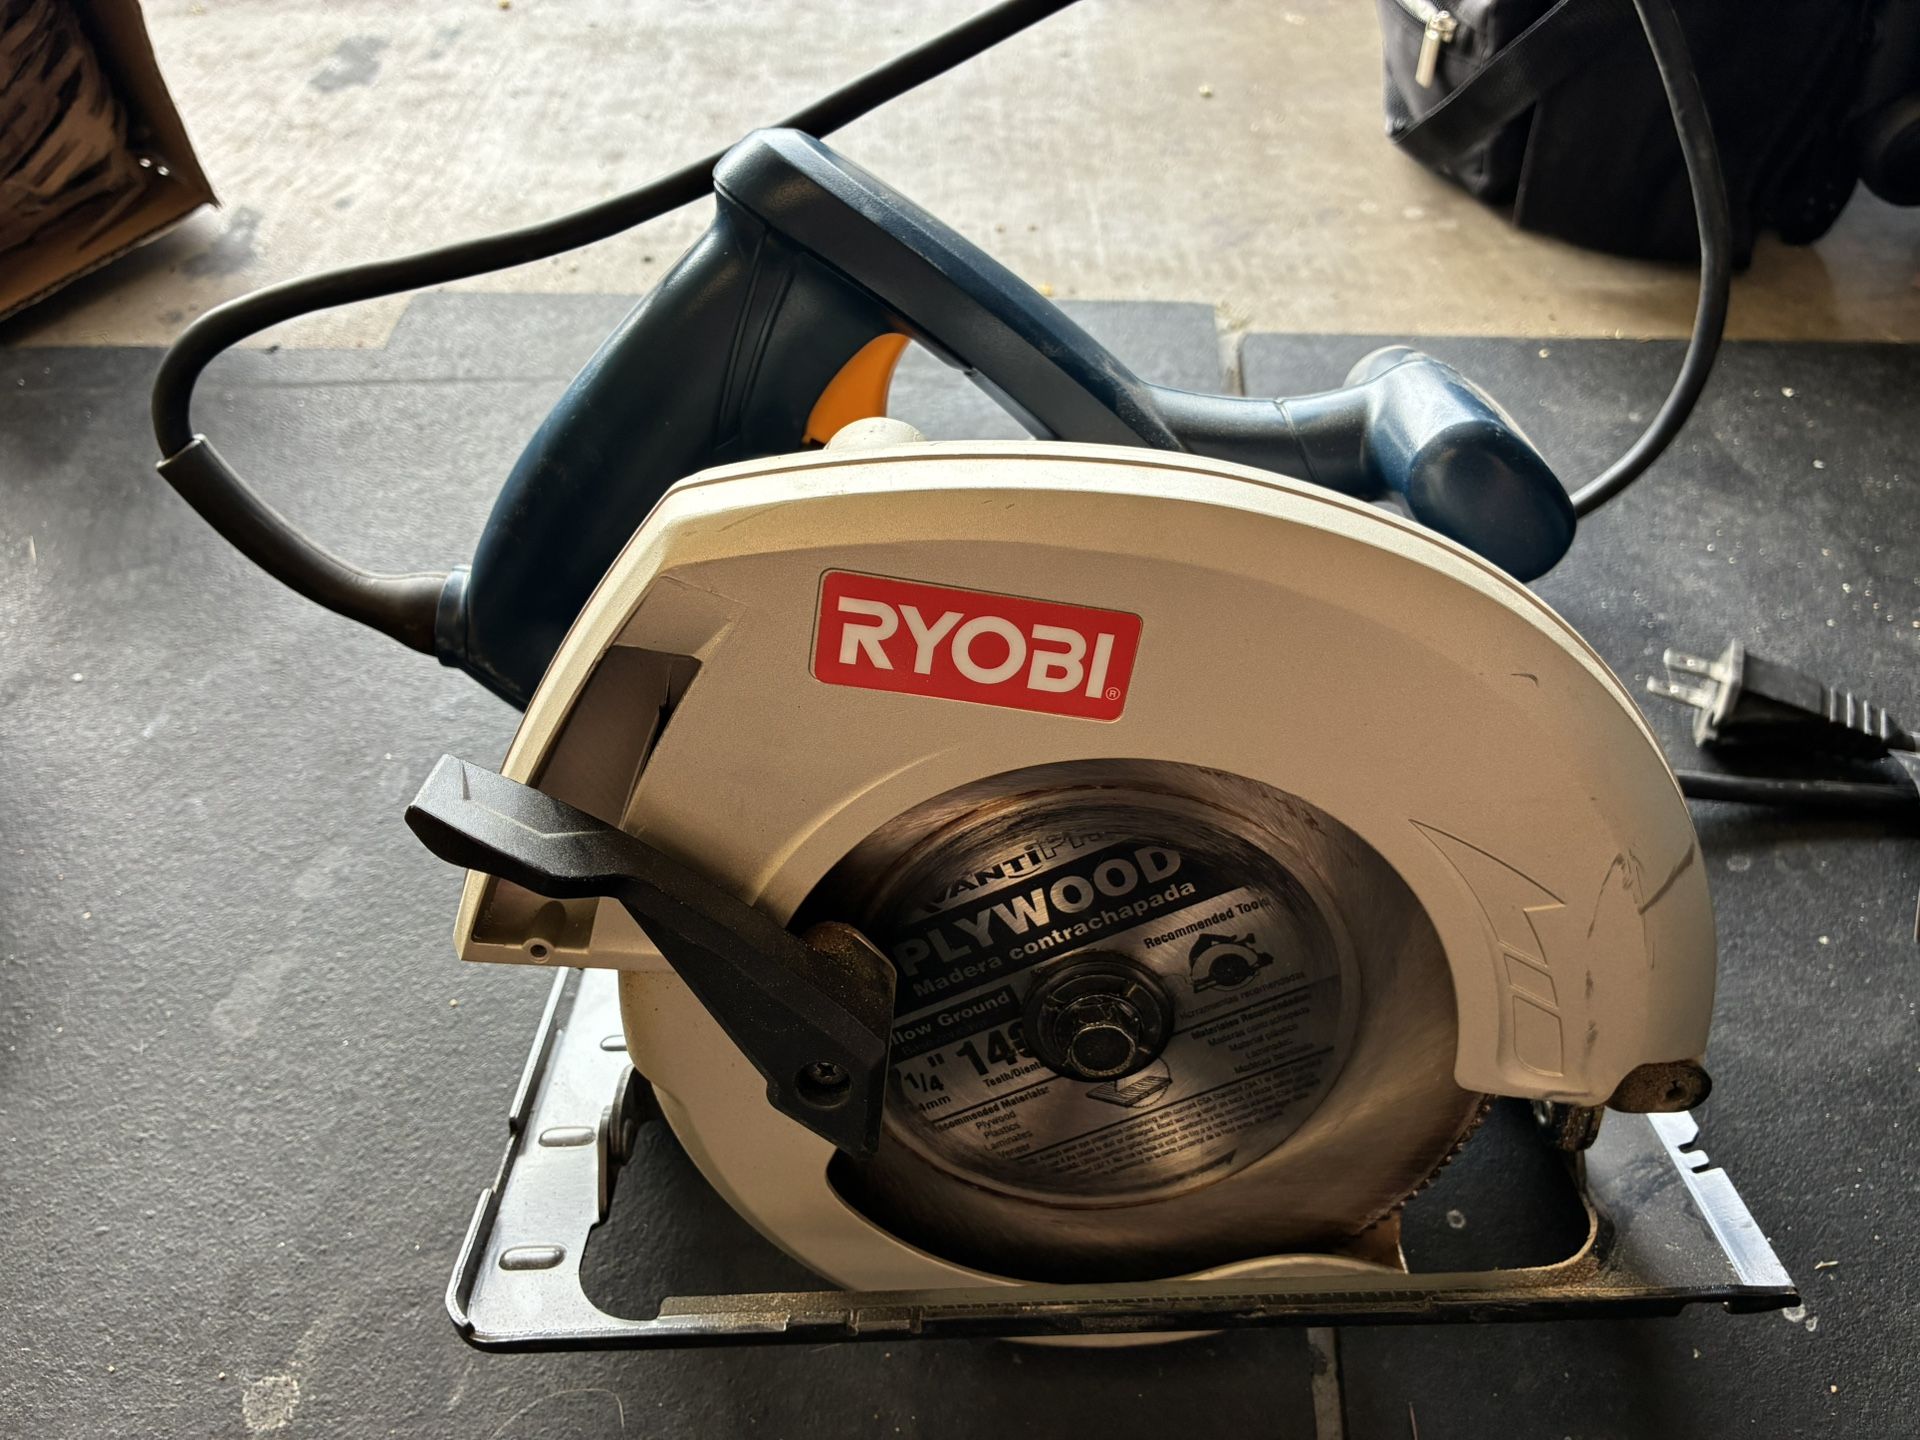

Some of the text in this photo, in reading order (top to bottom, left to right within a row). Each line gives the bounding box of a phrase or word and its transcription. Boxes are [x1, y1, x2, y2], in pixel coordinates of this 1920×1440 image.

[838, 596, 1115, 698] RYOBI
[894, 847, 1181, 976] PLYWOOD
[913, 882, 1196, 997] Madera contrachapada
[1144, 908, 1234, 949] Recommended
[891, 1023, 932, 1046] llow
[937, 991, 1010, 1027] Ground
[983, 1061, 1042, 1088] Teeth/Dient
